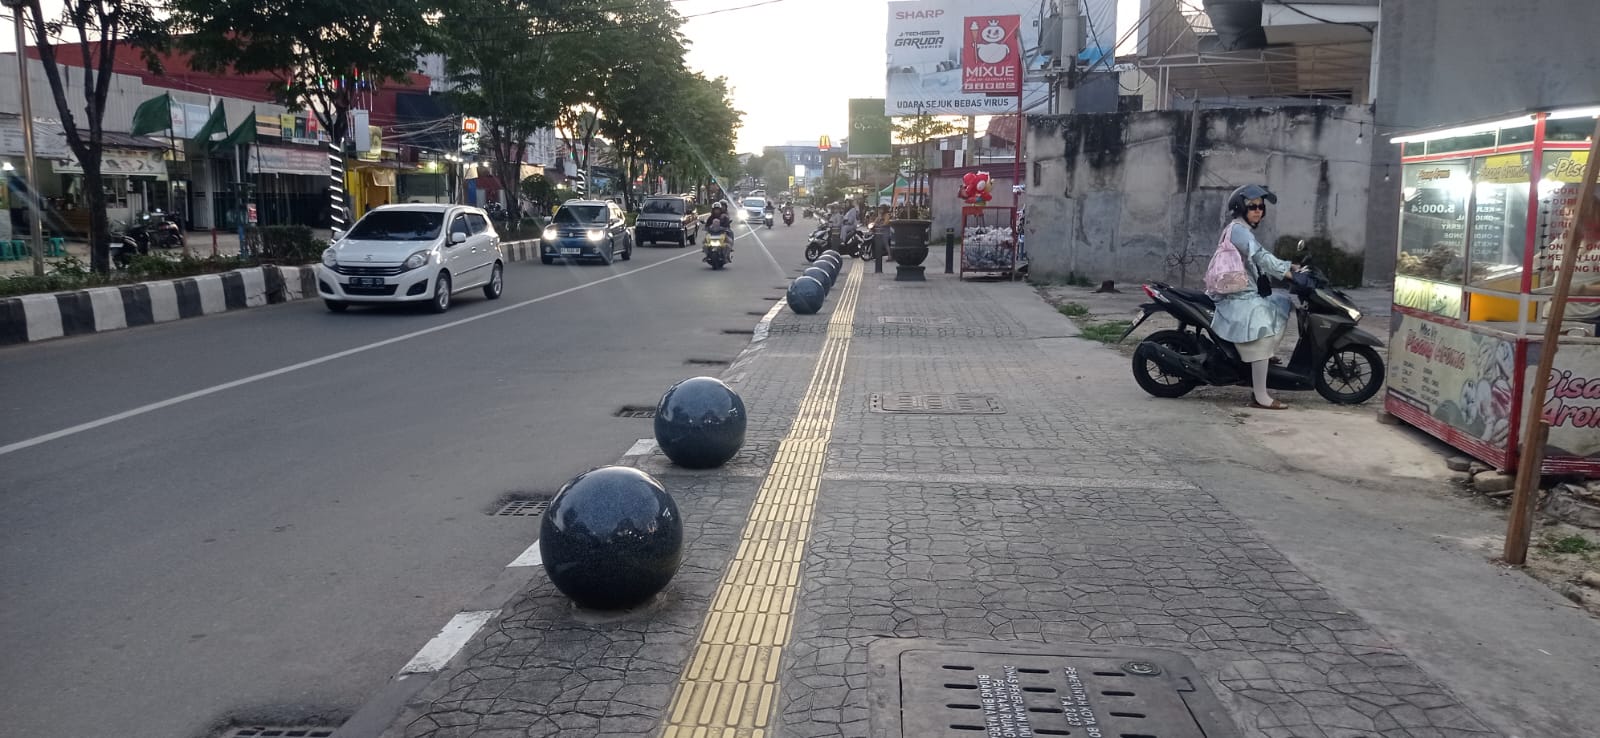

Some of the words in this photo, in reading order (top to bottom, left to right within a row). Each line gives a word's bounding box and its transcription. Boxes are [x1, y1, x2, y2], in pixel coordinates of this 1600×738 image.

[896, 9, 945, 20] SHARP
[894, 36, 945, 49] GARUDA
[966, 65, 1015, 77] MIXUE
[897, 99, 924, 109] UDARA
[925, 99, 953, 108] SEJUK
[954, 98, 982, 108] BEBAS
[983, 98, 1009, 107] VIRUS
[1003, 665, 1018, 683] DINAS
[977, 675, 993, 698] BIDANG
[1064, 666, 1089, 706] PEMERINTAH
[1079, 706, 1097, 725] KOTA
[993, 679, 1012, 713] PENATAAN
[1009, 684, 1028, 722] PEKERJAAN
[982, 698, 997, 715] BINA
[999, 713, 1017, 738] RUANG
[1064, 708, 1082, 726] 2023
[986, 716, 1002, 738] MARG
